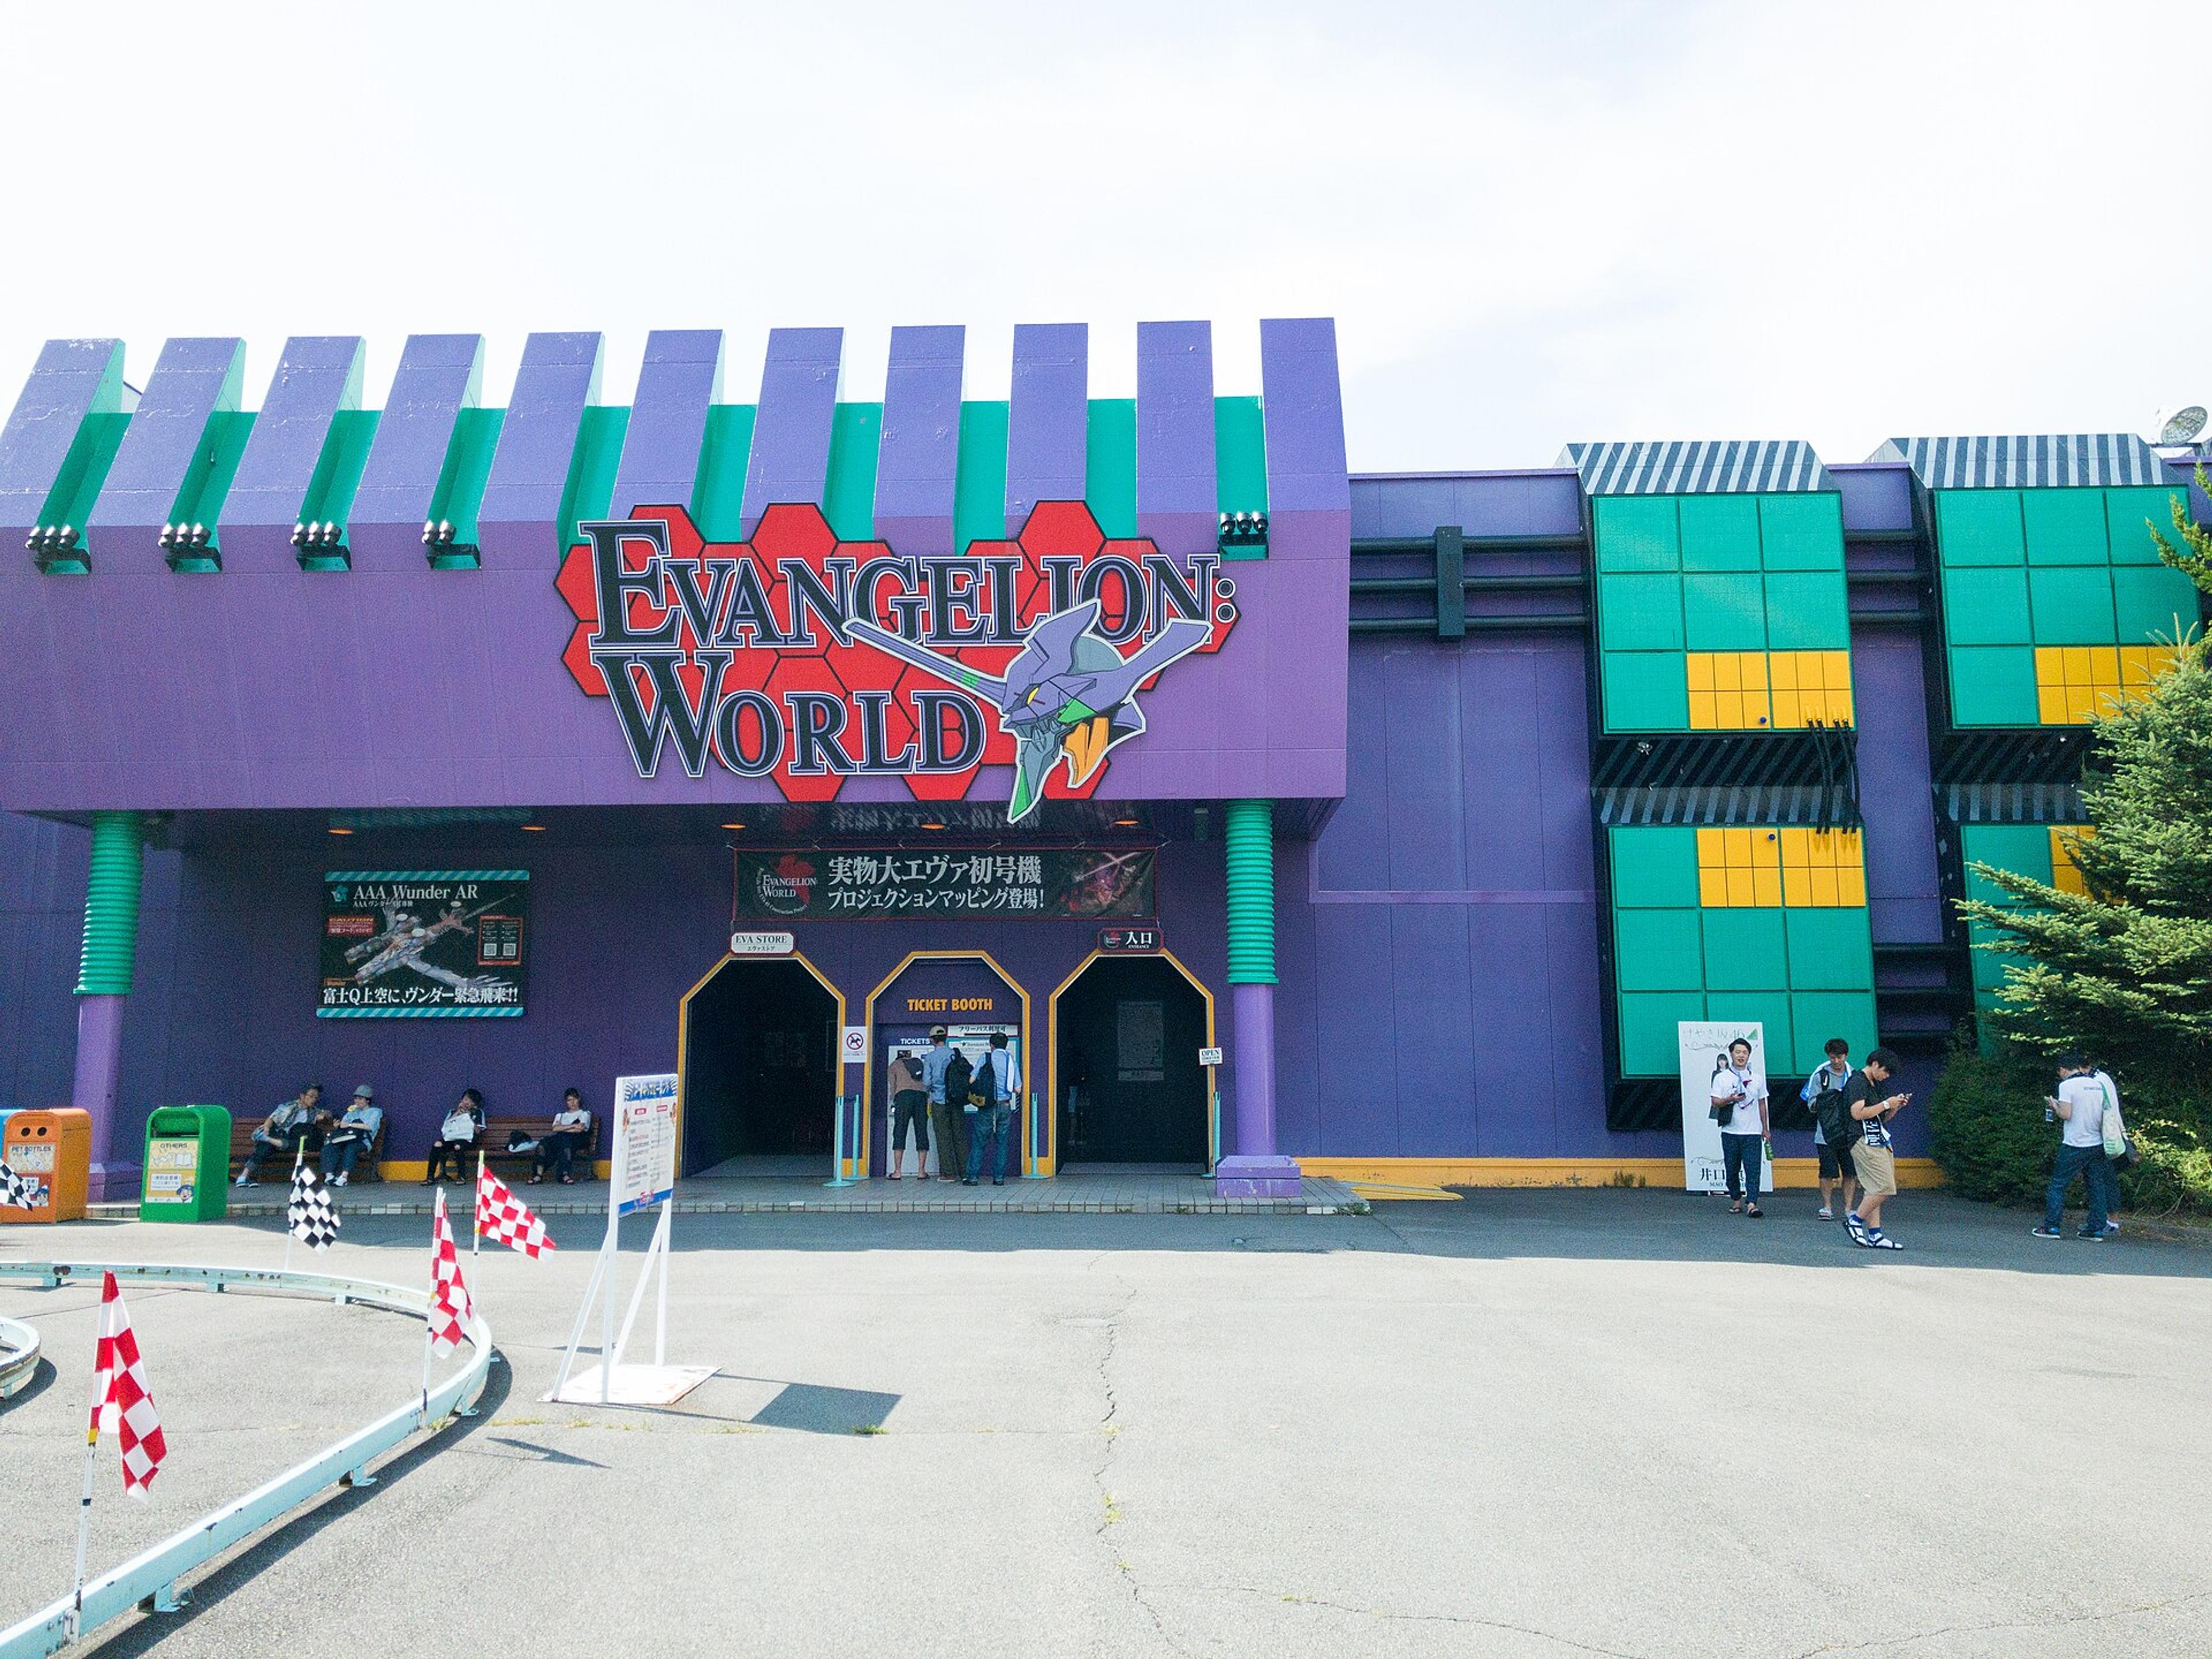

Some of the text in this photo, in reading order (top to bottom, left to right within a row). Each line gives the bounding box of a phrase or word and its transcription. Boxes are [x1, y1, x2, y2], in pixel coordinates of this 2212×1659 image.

[591, 649, 987, 778] WORLD
[828, 855, 1042, 885] 実物大エヴァ初号機
[353, 884, 478, 900] AAA Wunder AR
[762, 886, 796, 897] WORLD
[1126, 931, 1152, 945] 入口
[907, 998, 993, 1012] TICKET BOOTH
